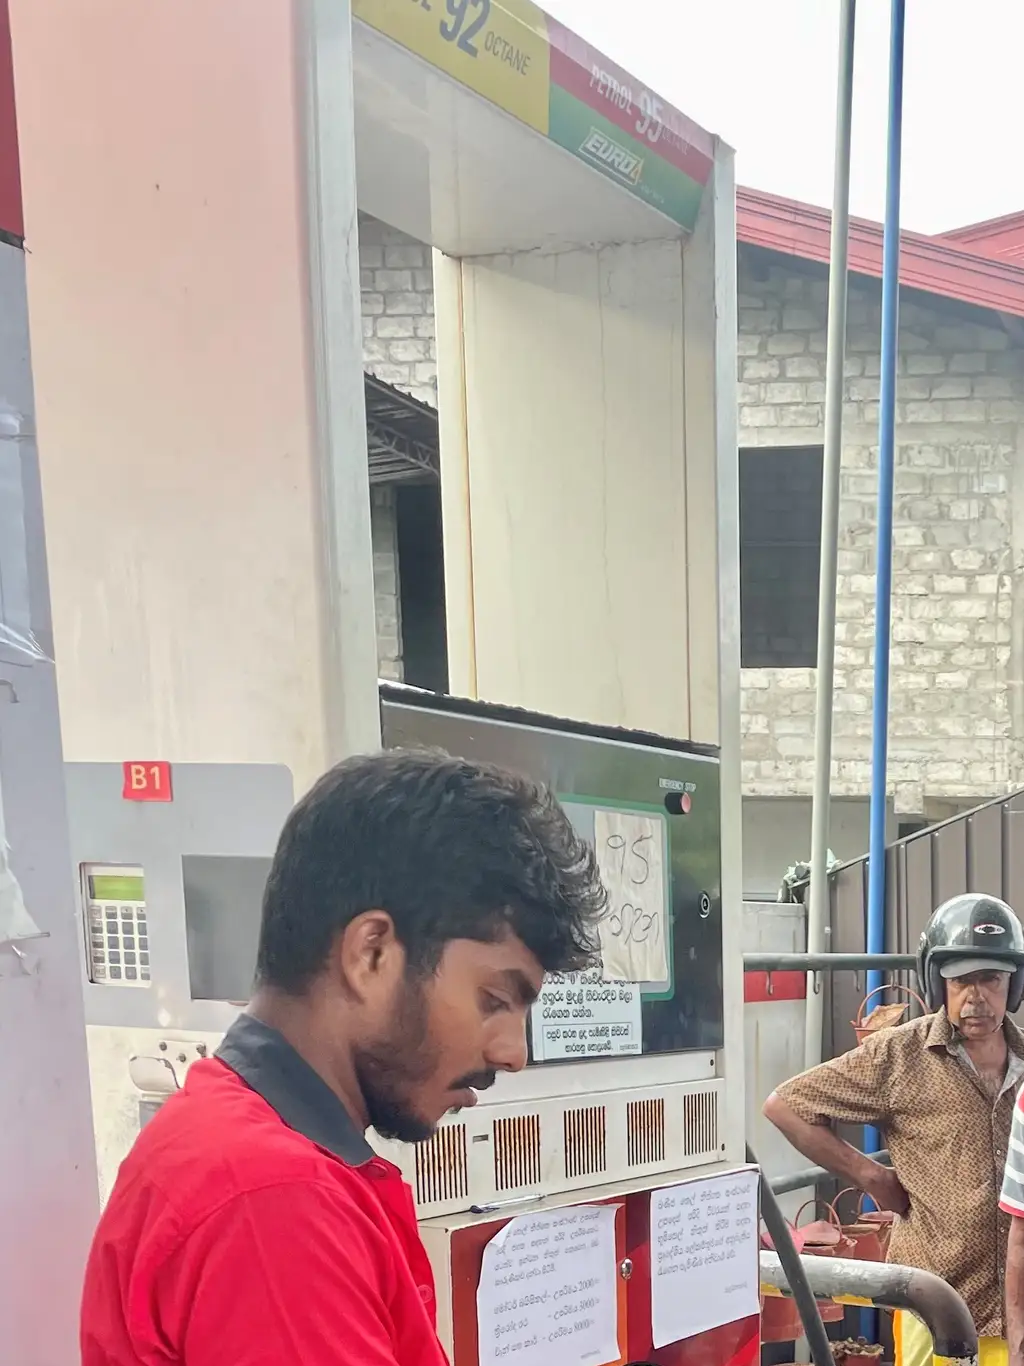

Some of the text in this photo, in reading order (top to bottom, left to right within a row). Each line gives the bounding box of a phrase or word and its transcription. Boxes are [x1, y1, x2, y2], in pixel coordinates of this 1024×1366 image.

[439, 0, 531, 76] 92 OCTANE
[589, 62, 633, 116] PETROL
[131, 765, 161, 790] B1
[606, 833, 653, 885] 95
